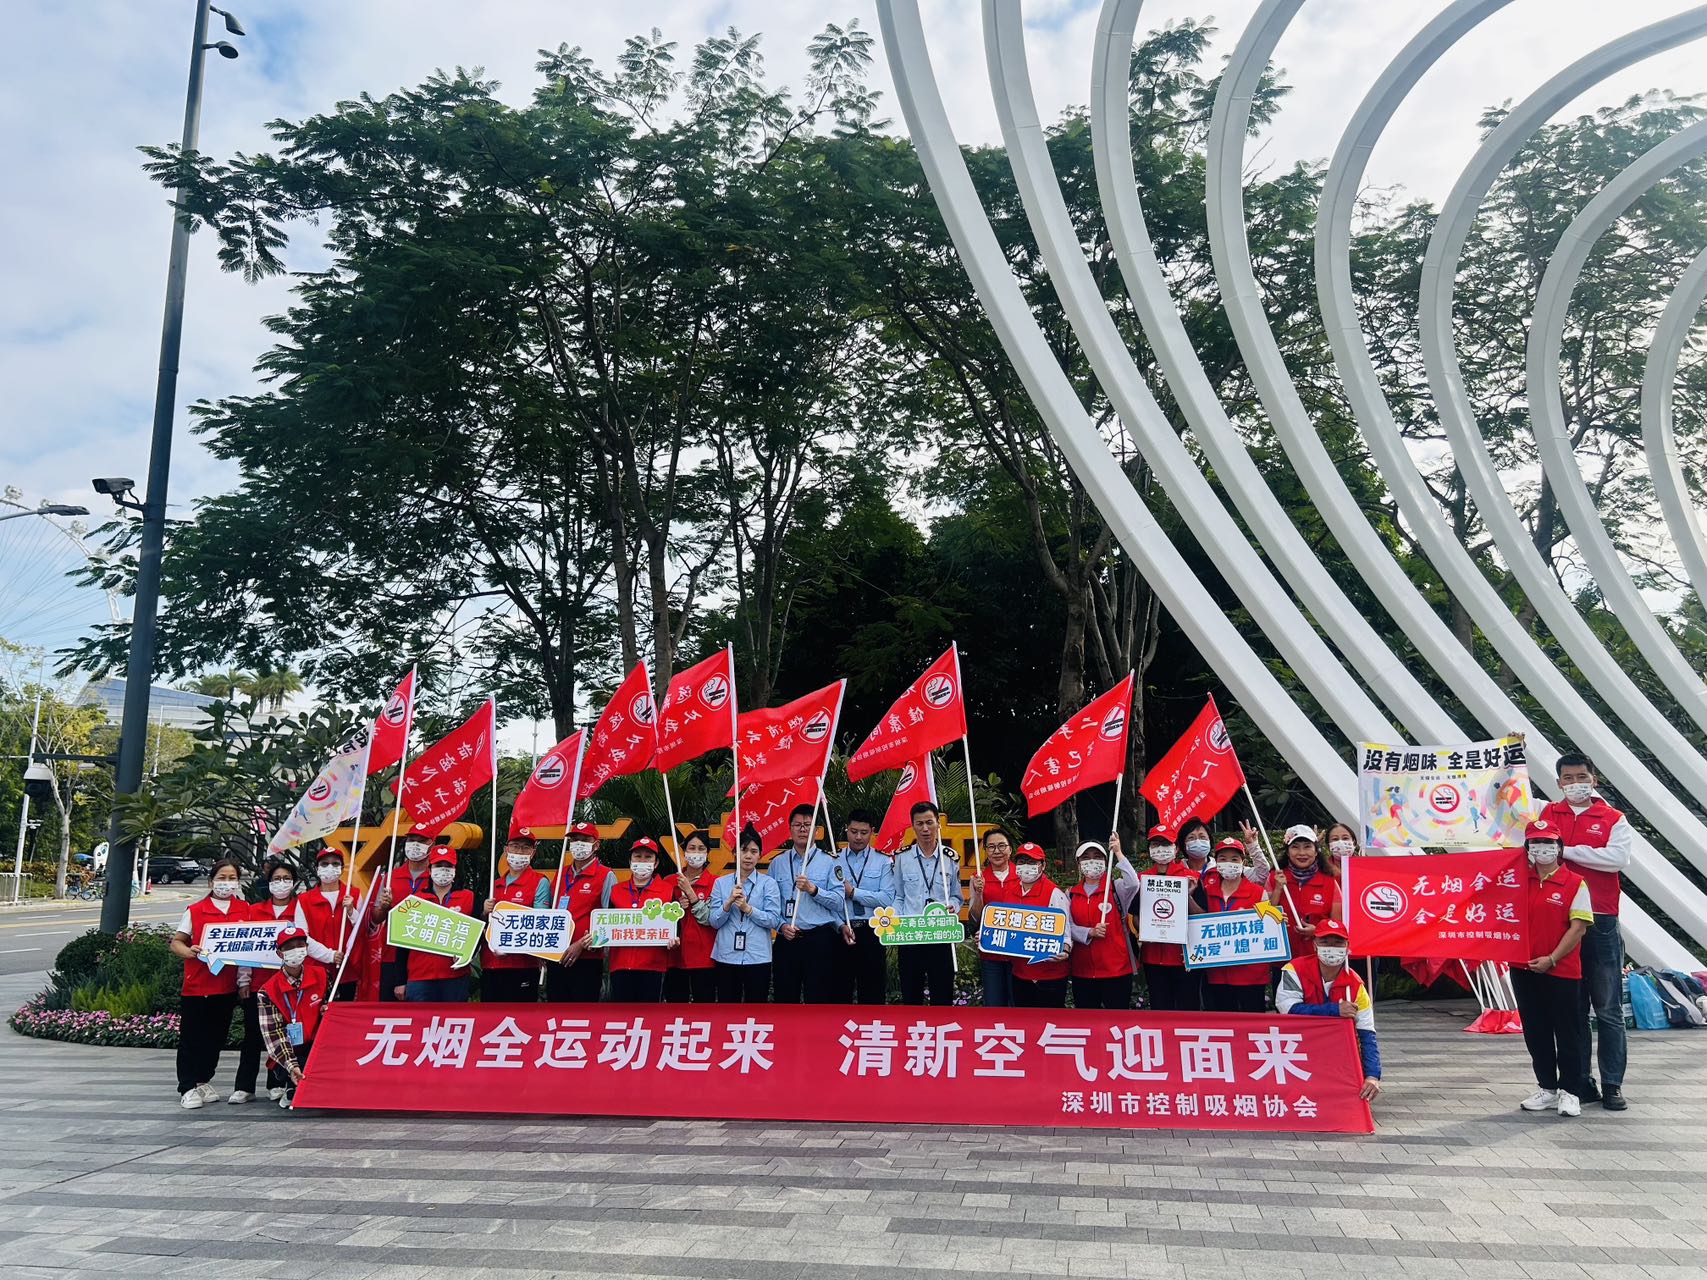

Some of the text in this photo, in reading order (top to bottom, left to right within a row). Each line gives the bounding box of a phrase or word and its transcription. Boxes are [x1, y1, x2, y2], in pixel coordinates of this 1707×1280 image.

[1363, 743, 1526, 771] 没有烟味 全是好运
[1147, 878, 1182, 888] 禁止吸烟
[1412, 869, 1520, 896] 无烟全运
[505, 914, 566, 930] 无烟家庭
[596, 913, 643, 925] 无烟环境
[899, 917, 956, 928] 天青色等烟雨
[994, 910, 1055, 932] 无烟全运
[1412, 903, 1520, 925] 全是好运
[406, 910, 471, 936] 无烟全运
[1201, 920, 1264, 939] 无烟环境
[208, 927, 277, 939] 全运展风采
[402, 925, 466, 950] 文明同行
[498, 931, 560, 948] 更多的爱
[612, 928, 669, 940] 你我更亲近
[886, 930, 962, 941] 而我在等无烟的你
[1438, 931, 1520, 941] 深圳市控制吸烟协会
[213, 940, 278, 953] 无烟赢未来
[357, 1015, 1312, 1086] 无烟全运动起来 清新空气迎面来
[1061, 1091, 1319, 1120] 深圳市控制吸烟协会
